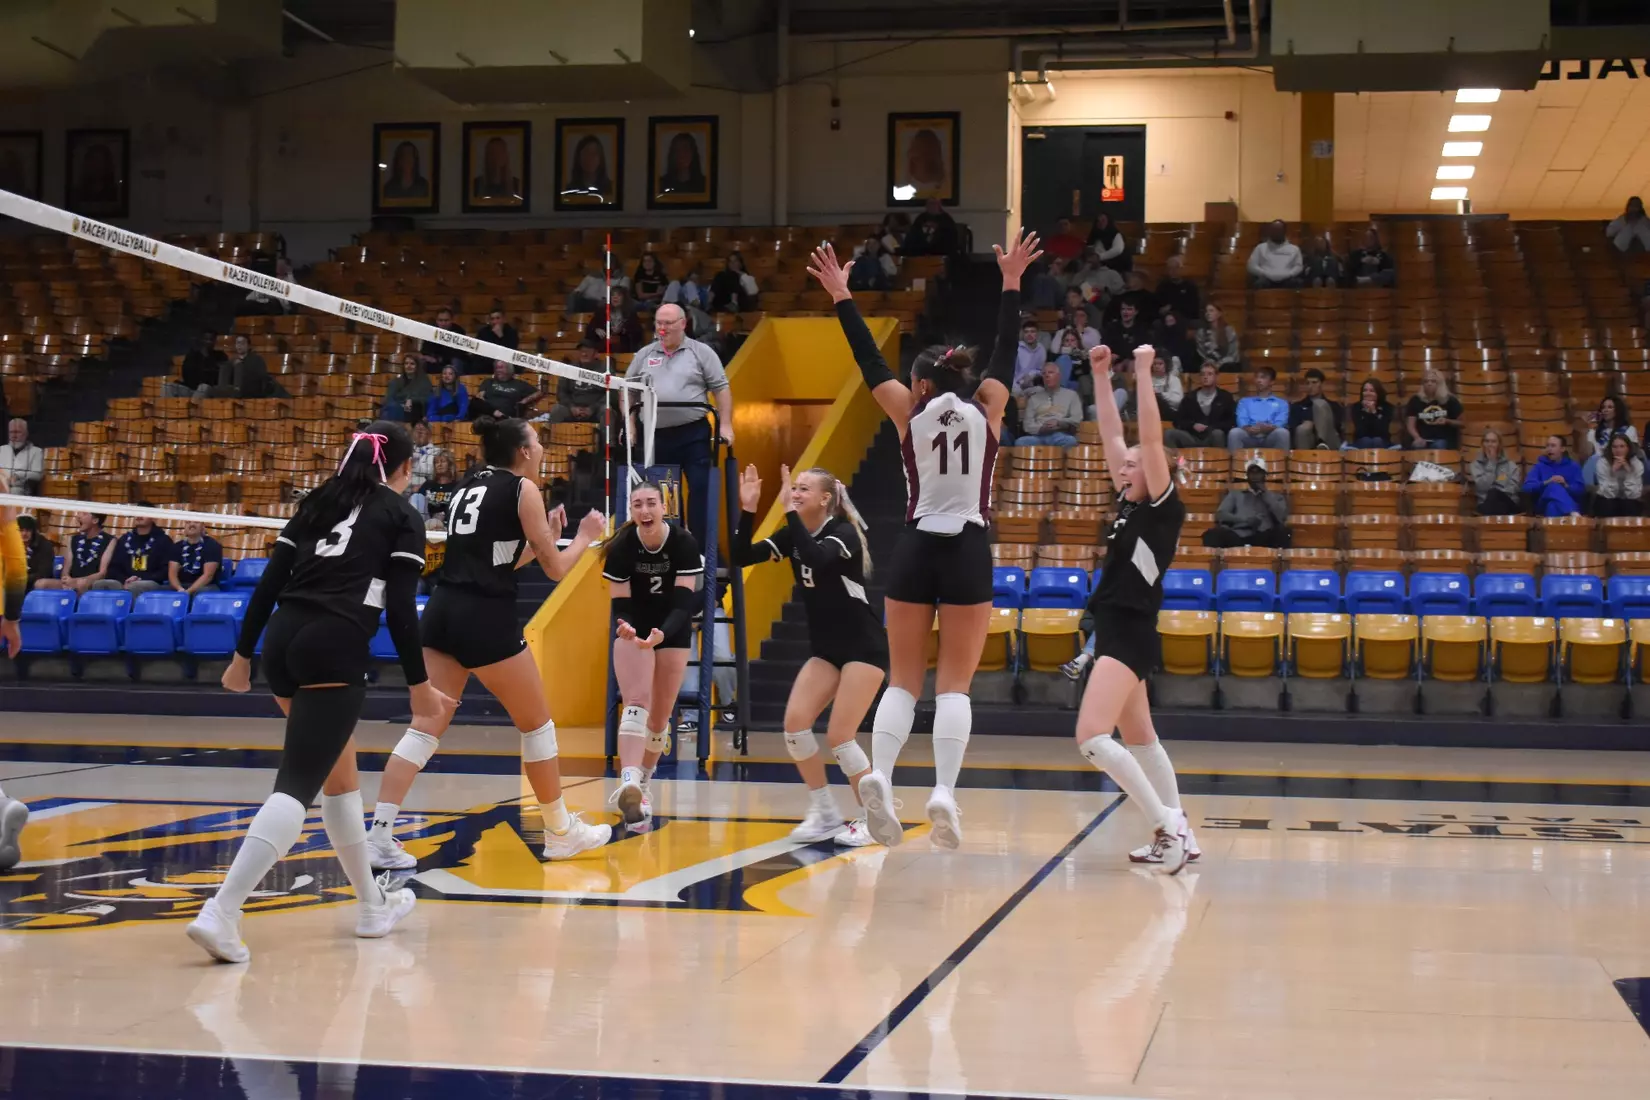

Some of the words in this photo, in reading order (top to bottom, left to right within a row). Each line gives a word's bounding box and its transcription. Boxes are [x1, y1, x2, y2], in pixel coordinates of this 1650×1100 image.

[81, 221, 107, 240] RACER
[107, 228, 152, 254] VOLLEYBALL
[229, 267, 249, 281] RACER
[249, 274, 284, 294] VOLLEYBALL
[931, 430, 970, 475] 11
[448, 485, 488, 536] 13
[315, 503, 363, 557] 3
[650, 576, 663, 594] 2
[801, 564, 816, 588] 9
[1201, 817, 1625, 839] STATE
